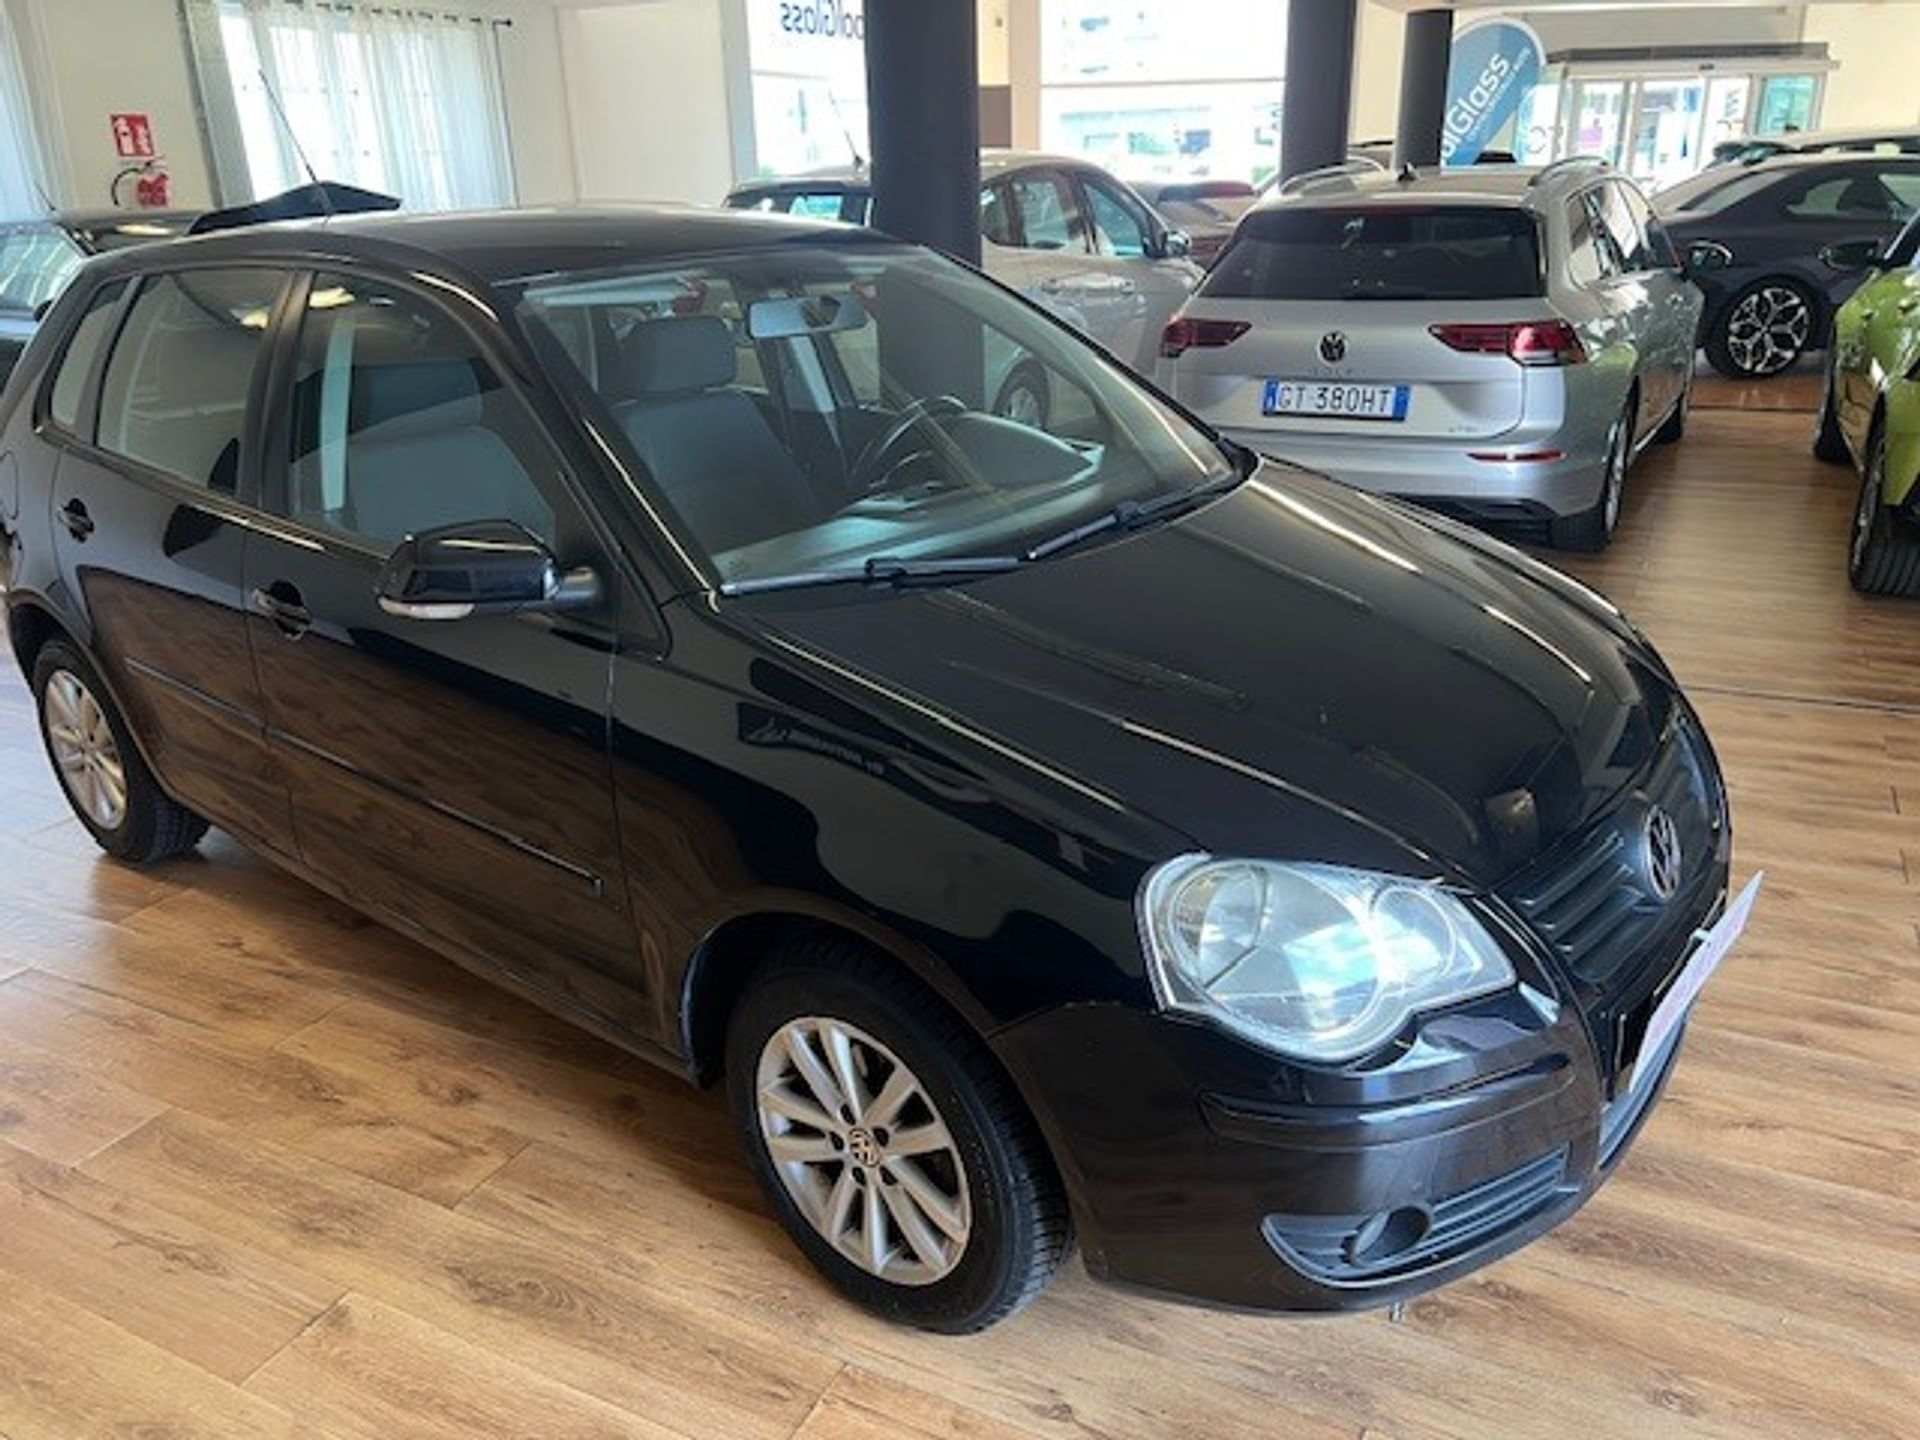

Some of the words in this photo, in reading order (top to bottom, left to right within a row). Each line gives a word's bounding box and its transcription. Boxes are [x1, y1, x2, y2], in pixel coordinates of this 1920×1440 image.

[1441, 54, 1510, 160] olGlass
[1278, 384, 1307, 411] GT
[1315, 385, 1393, 414] 380HT
